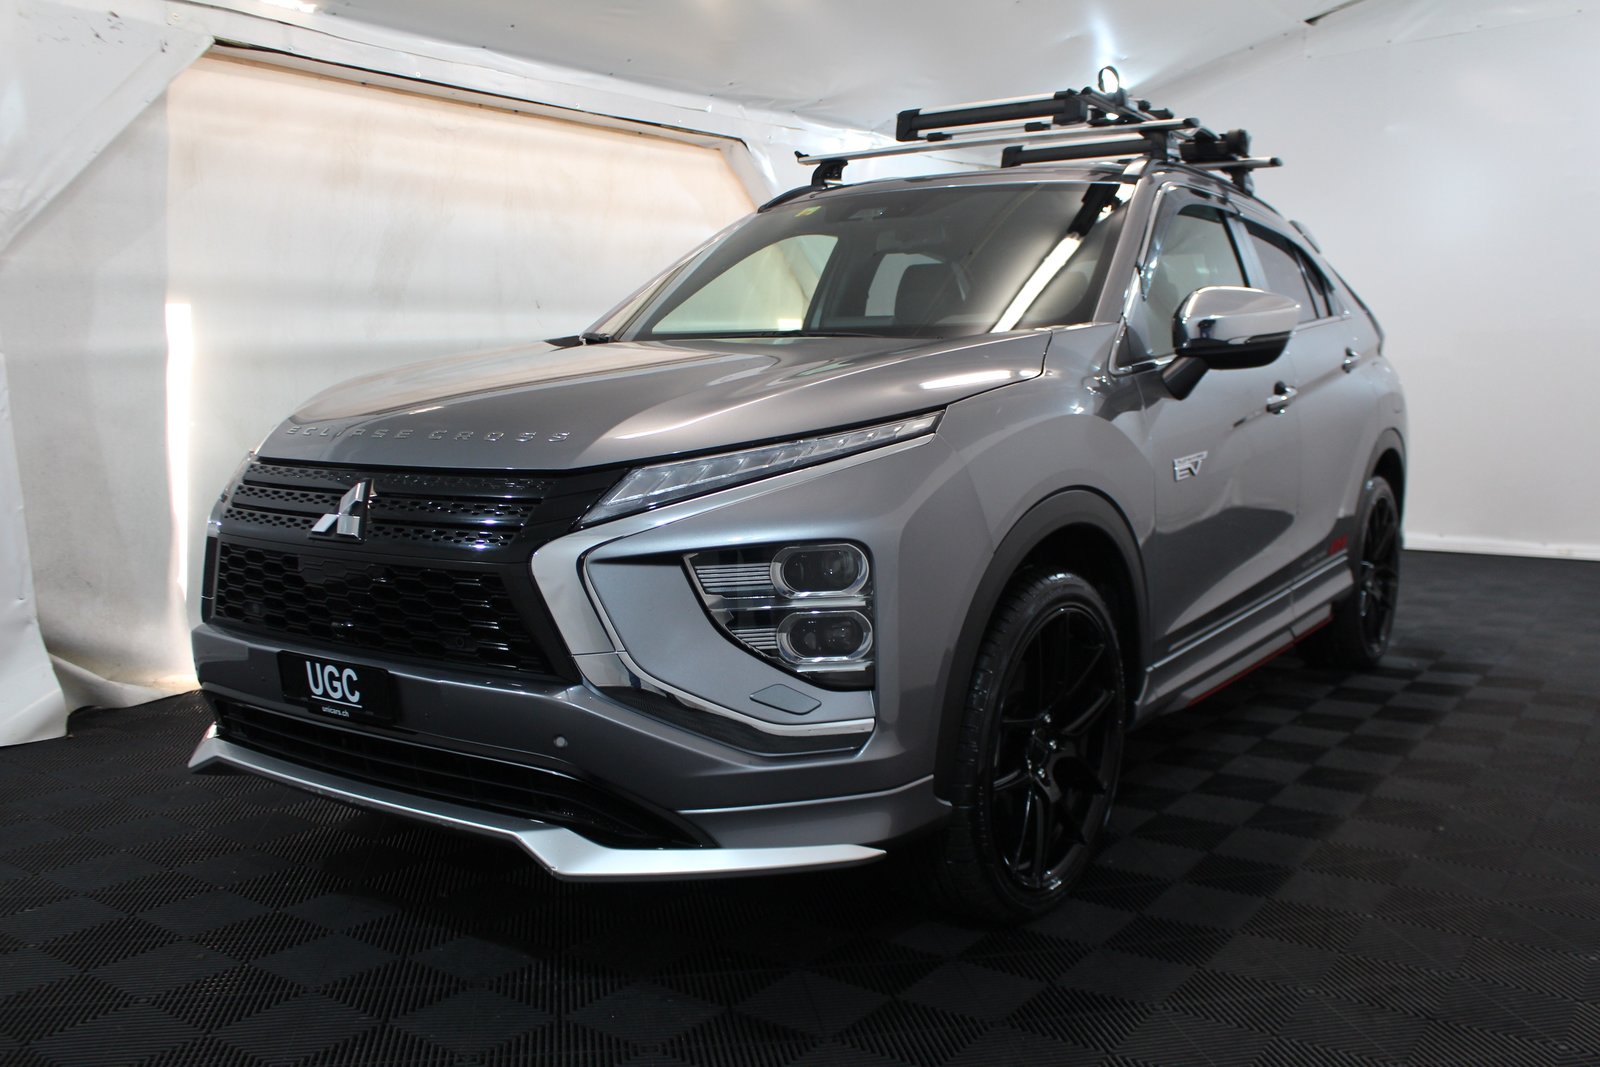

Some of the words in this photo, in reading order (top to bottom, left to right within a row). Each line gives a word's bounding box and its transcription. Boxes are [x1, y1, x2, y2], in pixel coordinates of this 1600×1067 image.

[286, 425, 414, 440] ECLIPSE
[427, 429, 571, 443] CROSS
[306, 661, 360, 703] UGC
[322, 706, 350, 718] unicars.ch
